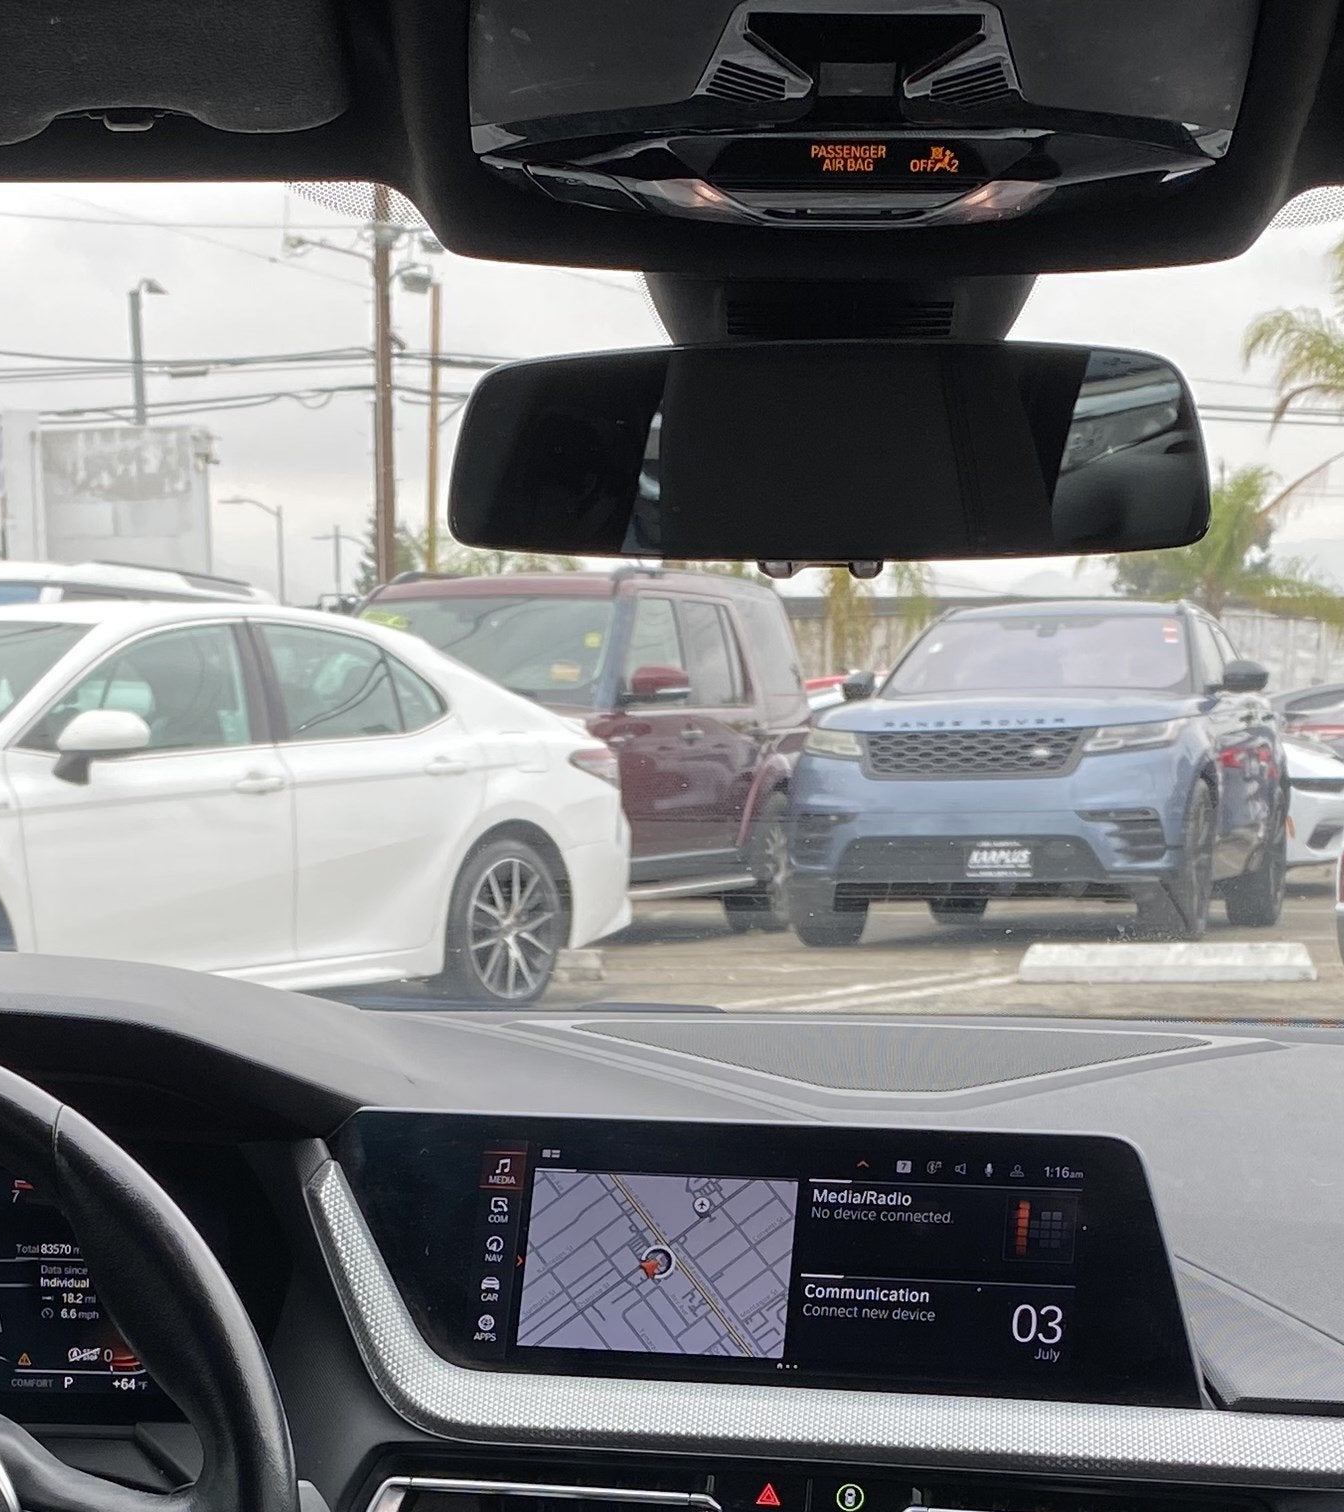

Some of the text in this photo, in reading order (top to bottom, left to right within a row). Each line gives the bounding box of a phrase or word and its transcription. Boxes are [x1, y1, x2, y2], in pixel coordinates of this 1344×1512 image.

[810, 145, 887, 159] PASSENGER
[822, 158, 874, 172] AIR BAG
[909, 159, 936, 173] OFF
[488, 1174, 516, 1186] MEDIA
[812, 1188, 912, 1207] Media/Radio
[487, 1213, 509, 1224] COM
[811, 1206, 955, 1224] No device connected.
[16, 1243, 72, 1256] Total 83570
[484, 1252, 503, 1264] NAV
[40, 1264, 88, 1275] Data since
[40, 1277, 90, 1289] Individual
[61, 1293, 83, 1304] 18.2
[480, 1291, 500, 1303] CAR
[804, 1284, 931, 1303] Communication
[60, 1308, 99, 1321] 6.6 mph
[802, 1303, 936, 1322] Connect new device
[1011, 1303, 1064, 1345] 03
[473, 1331, 497, 1342] APPS
[1034, 1348, 1061, 1363] July
[11, 1377, 53, 1388] COMFORT
[63, 1376, 74, 1389] P
[112, 1377, 136, 1390] +64
